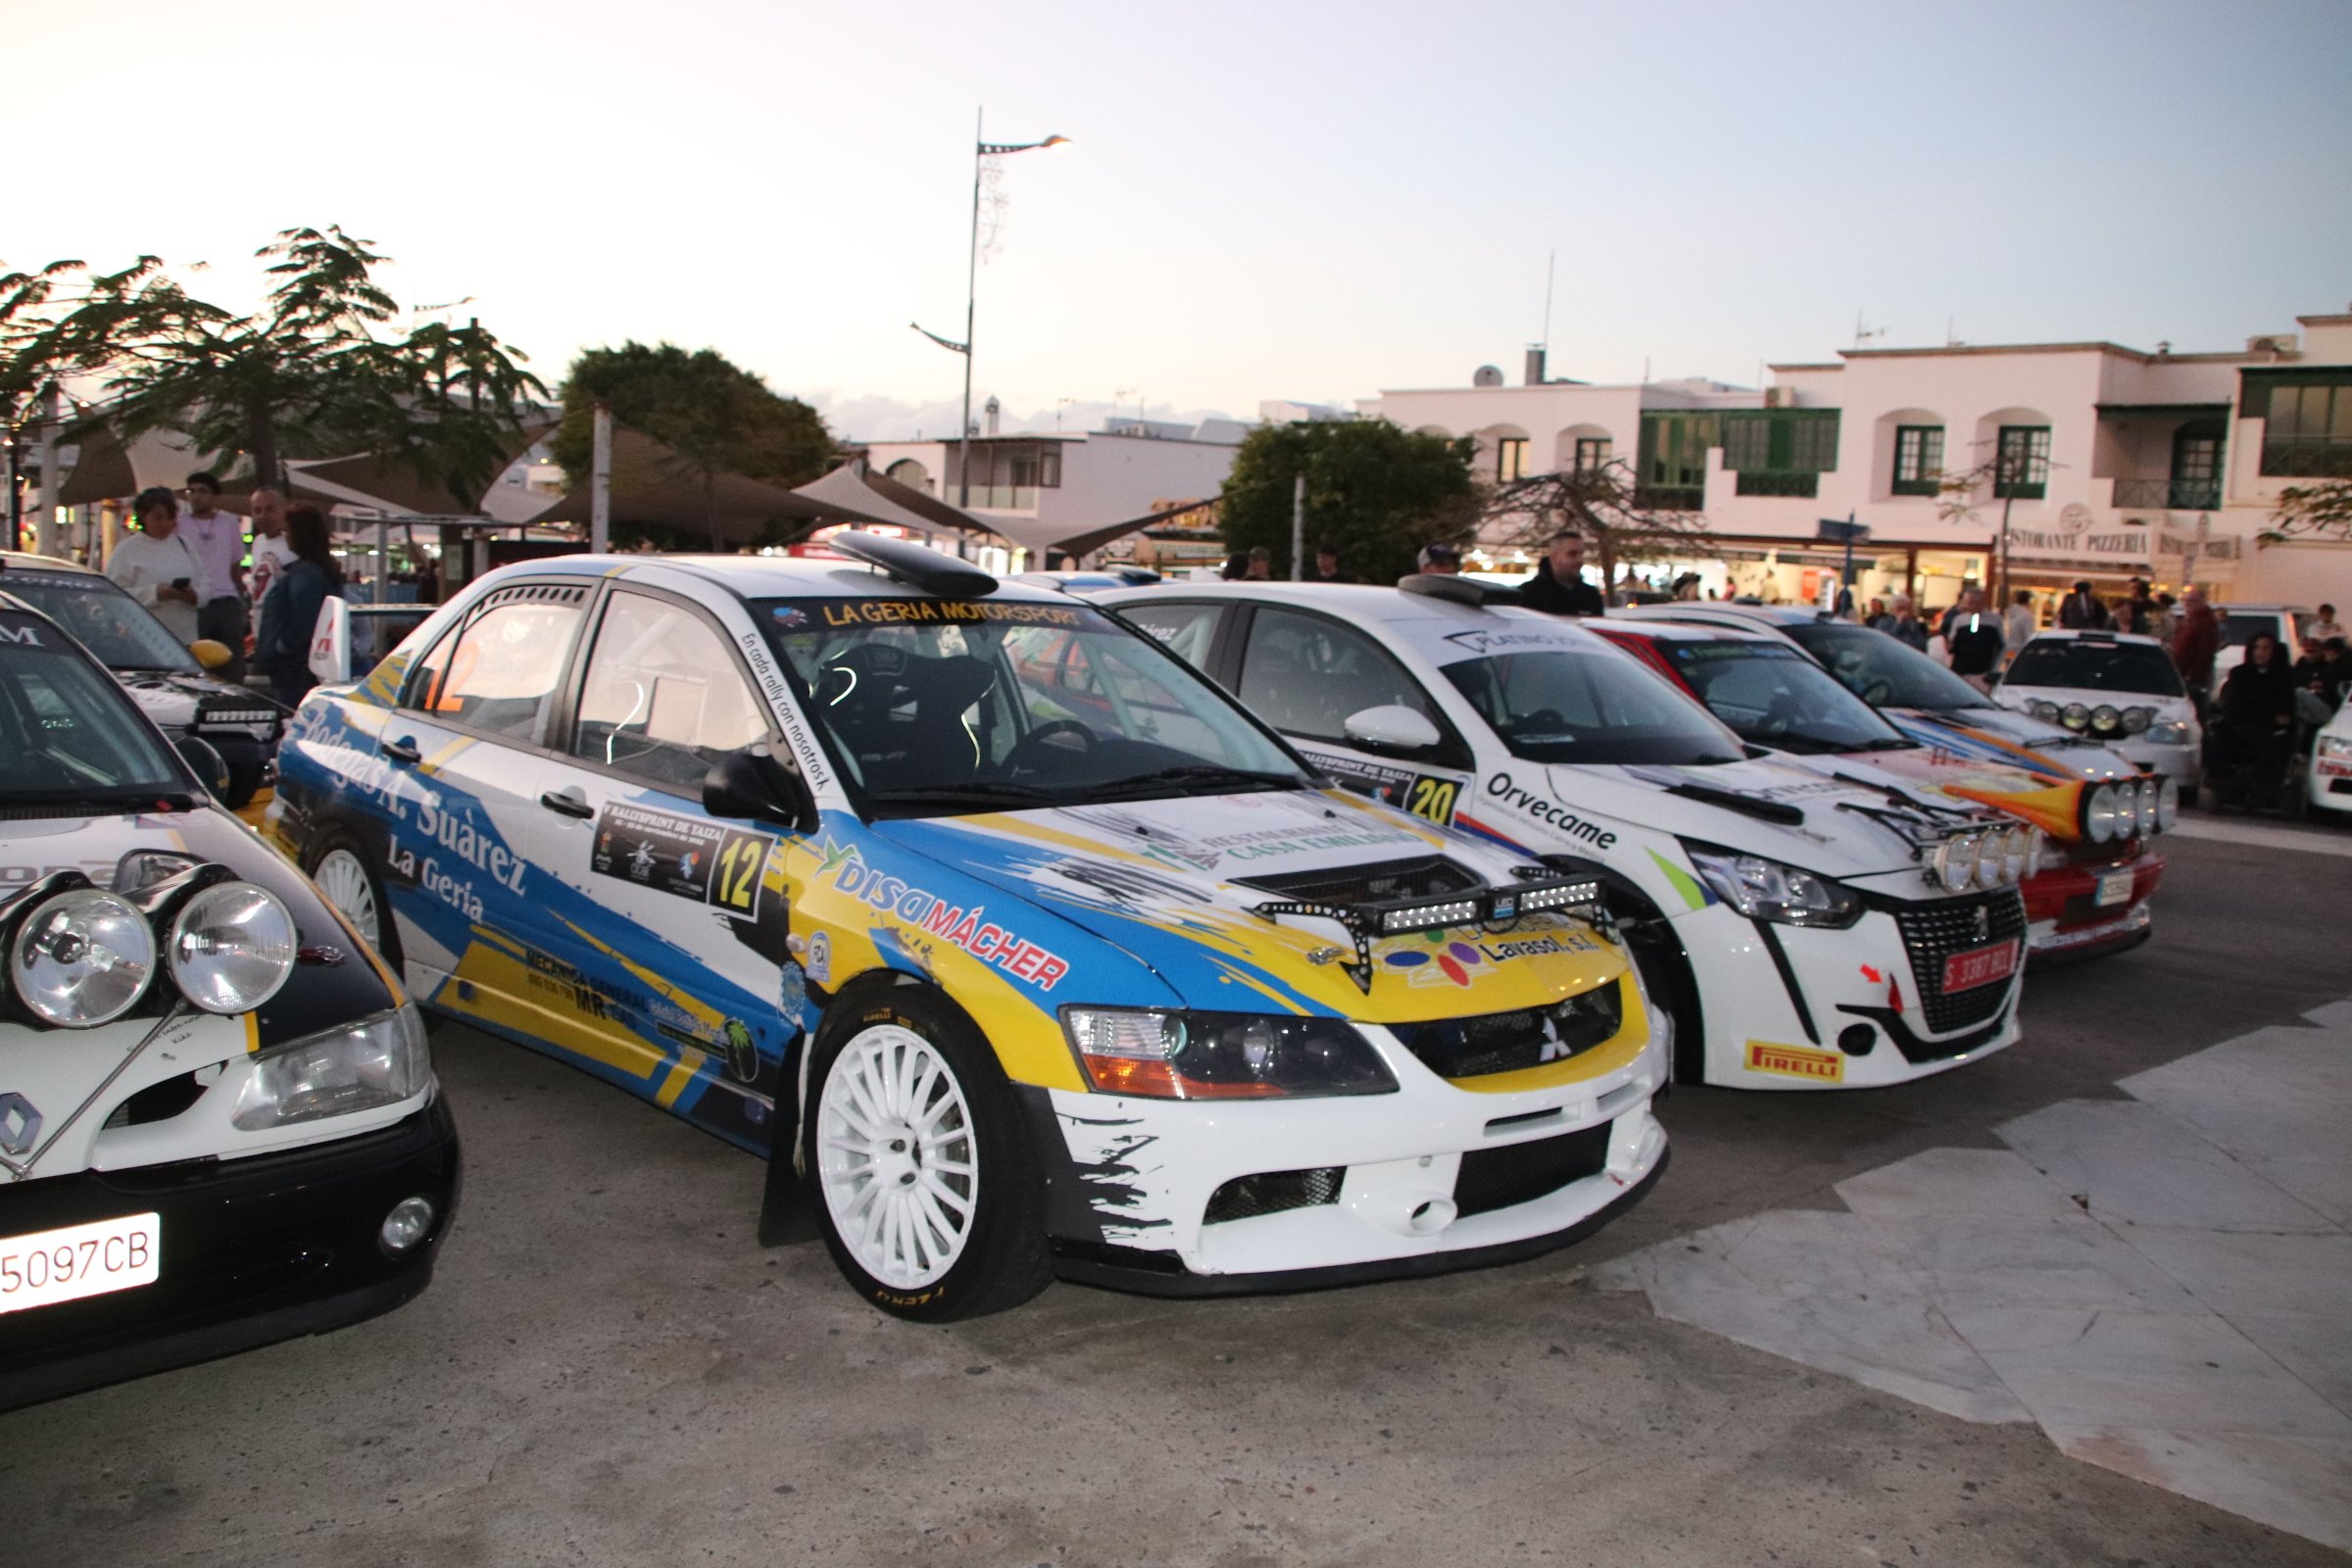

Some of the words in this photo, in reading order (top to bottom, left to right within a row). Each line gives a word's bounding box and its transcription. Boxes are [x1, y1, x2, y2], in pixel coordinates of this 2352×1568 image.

[2002, 528, 2077, 551] ISTORANTE
[2086, 532, 2146, 554] PIZZERIA
[823, 604, 860, 626] LA
[860, 601, 938, 623] GERIA
[940, 600, 1081, 626] MOTORSPORT
[424, 641, 479, 711] 12
[741, 633, 756, 646] En
[749, 646, 769, 674] cada
[763, 674, 785, 702] rally
[777, 700, 795, 724] con
[789, 723, 825, 782] nosotros
[1411, 779, 1454, 825] 20
[1488, 772, 1617, 850] Orvecame
[691, 823, 721, 841] YAIZA
[1226, 838, 1307, 860] CASA
[387, 835, 416, 878] La
[420, 857, 484, 924] Geria
[720, 836, 762, 907] 12
[1751, 1044, 1838, 1077] PIRELLI
[1, 1231, 148, 1294] 5097CB
